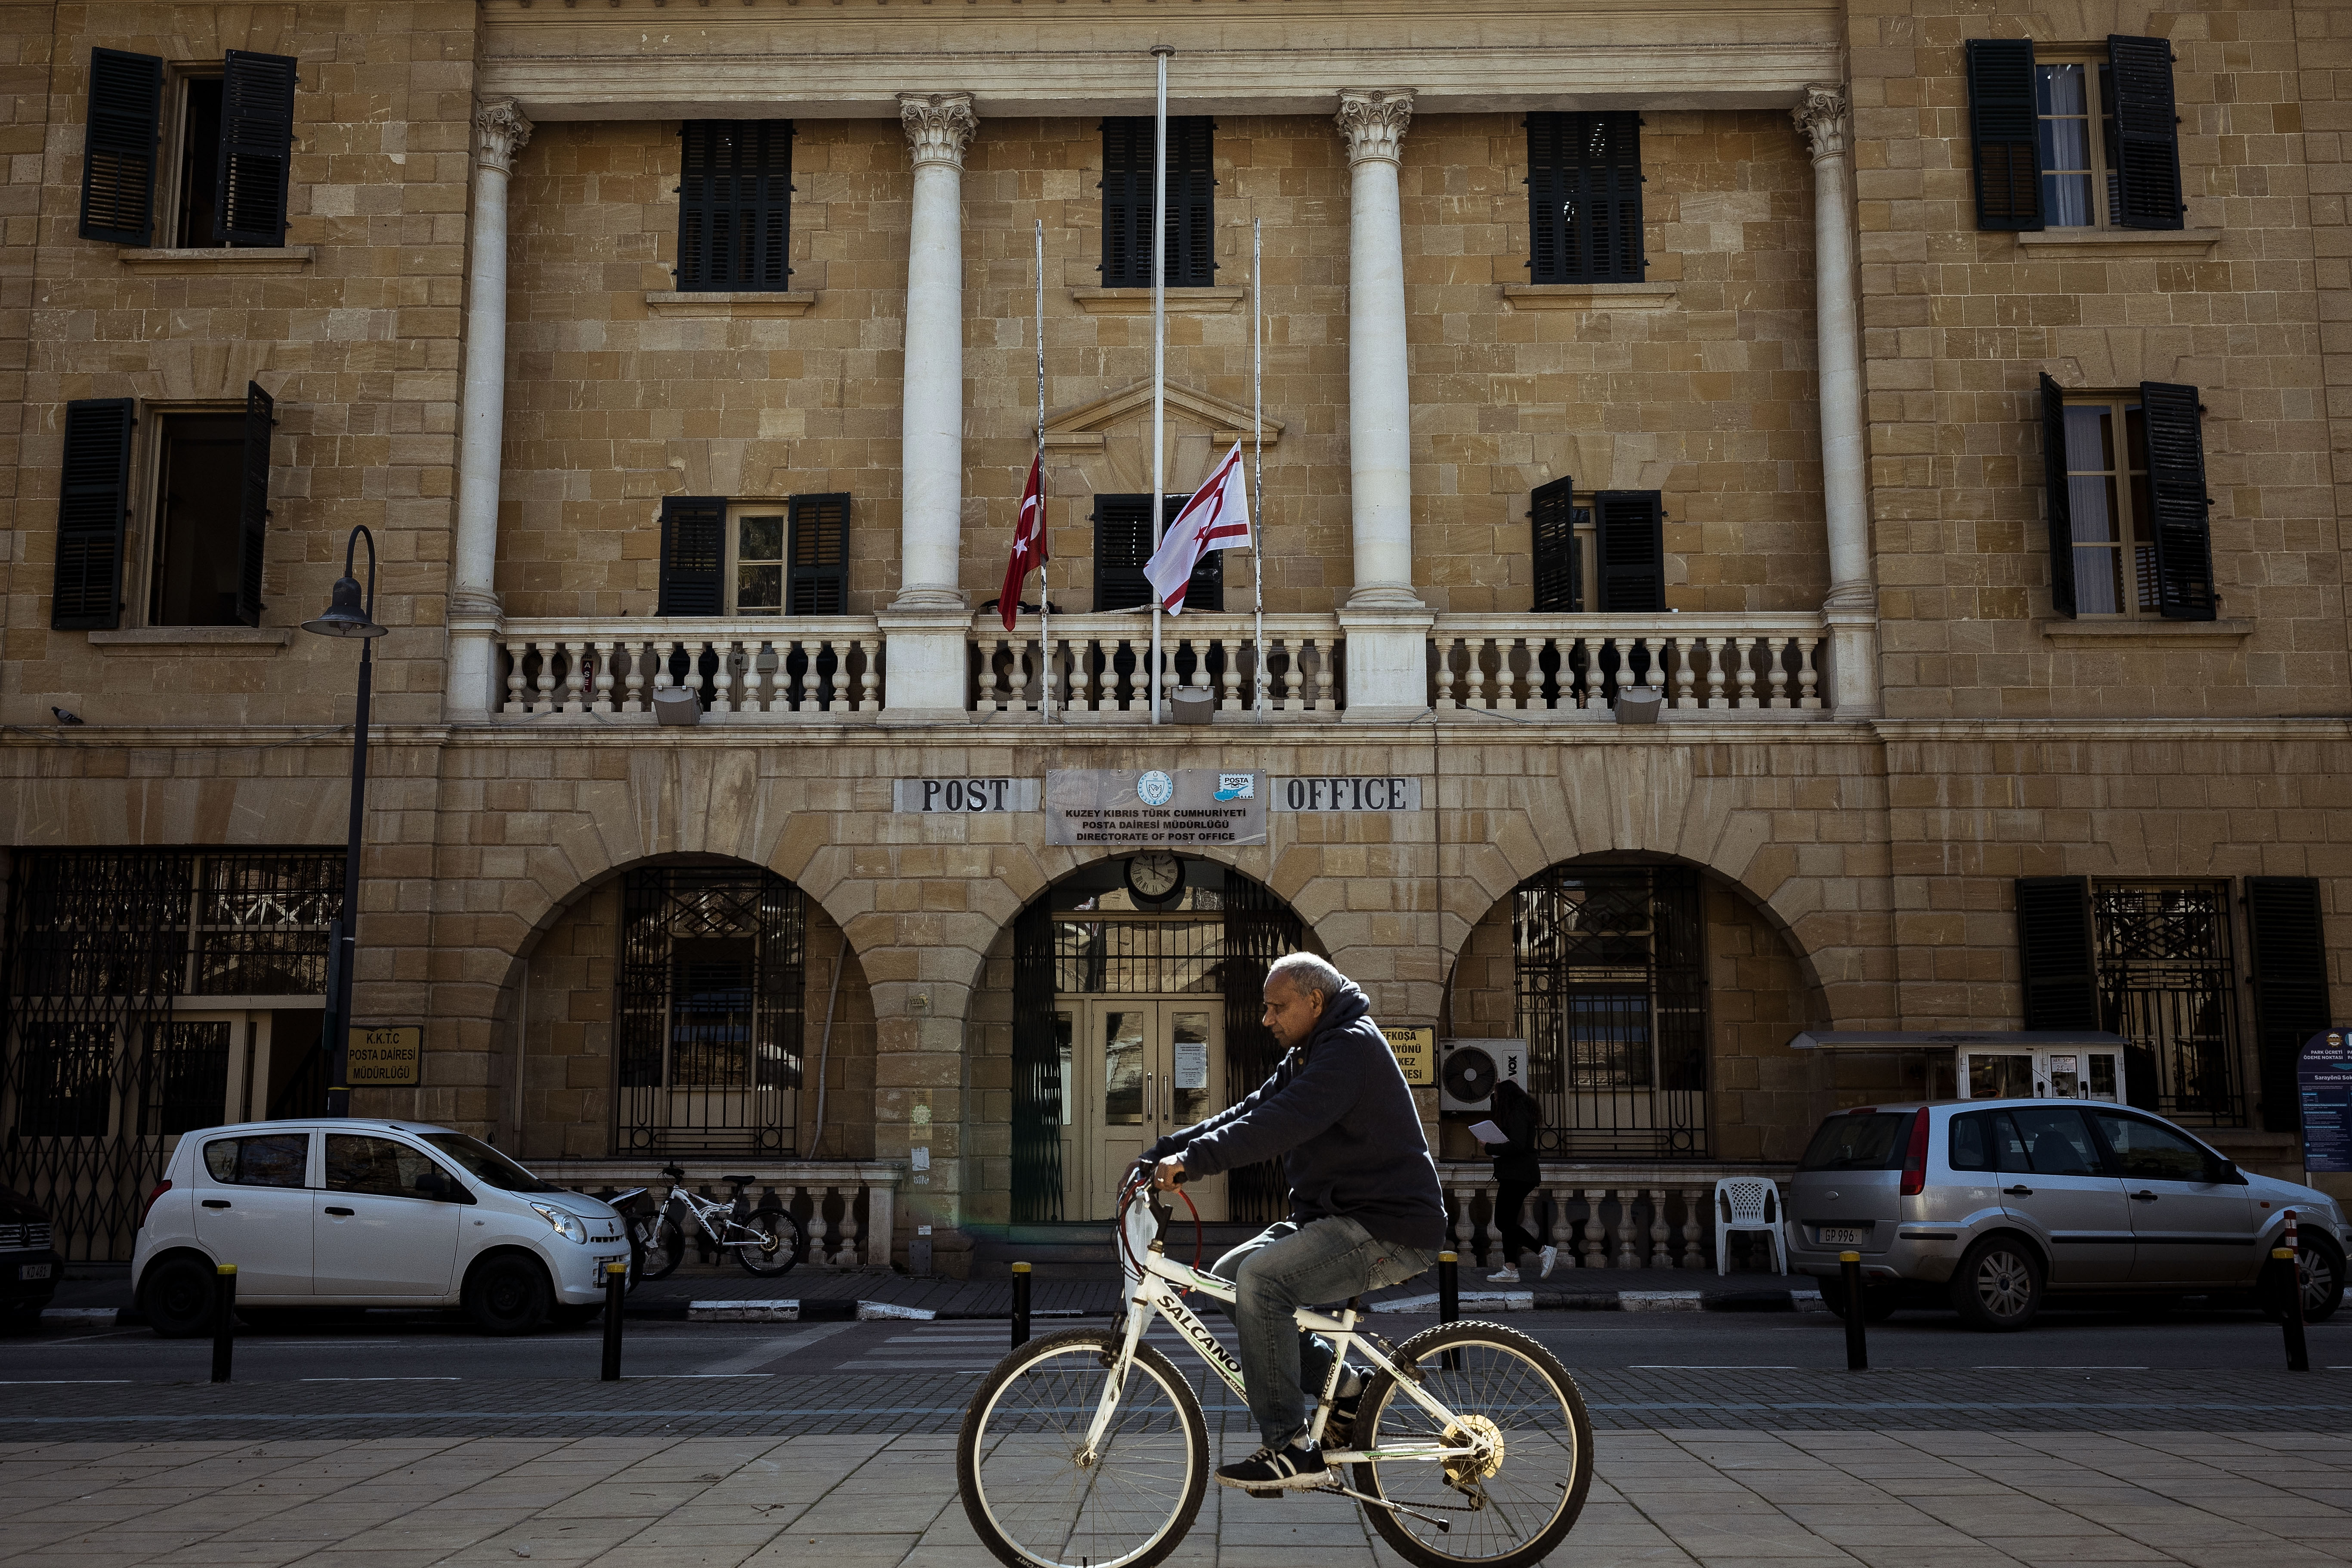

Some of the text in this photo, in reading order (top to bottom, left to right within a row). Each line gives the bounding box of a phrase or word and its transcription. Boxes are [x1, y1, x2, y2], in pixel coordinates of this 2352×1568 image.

[922, 779, 1009, 811] POST
[1287, 778, 1406, 810] OFFICE
[1142, 808, 1171, 817] TÜRK
[1174, 808, 1246, 817] CUMHURİYETİ
[1119, 820, 1159, 829] DAİRESİ
[1163, 820, 1229, 829] MÜDÜRLÜĞÜ
[366, 1033, 399, 1044] K.K.T.C
[349, 1047, 416, 1060] POSTA DAİRESİ
[353, 1065, 410, 1079] MÜDÜRLÜĞÜ
[1826, 1229, 1854, 1242] GP 996
[26, 1266, 46, 1278] KD 481
[1157, 1296, 1242, 1373] SALCANO
[1039, 1339, 1113, 1354] SALCAN
[1322, 1364, 1336, 1399] ALCANO
[1229, 1379, 1248, 1401] SALCAN
[1015, 1556, 1040, 1568] ORT
